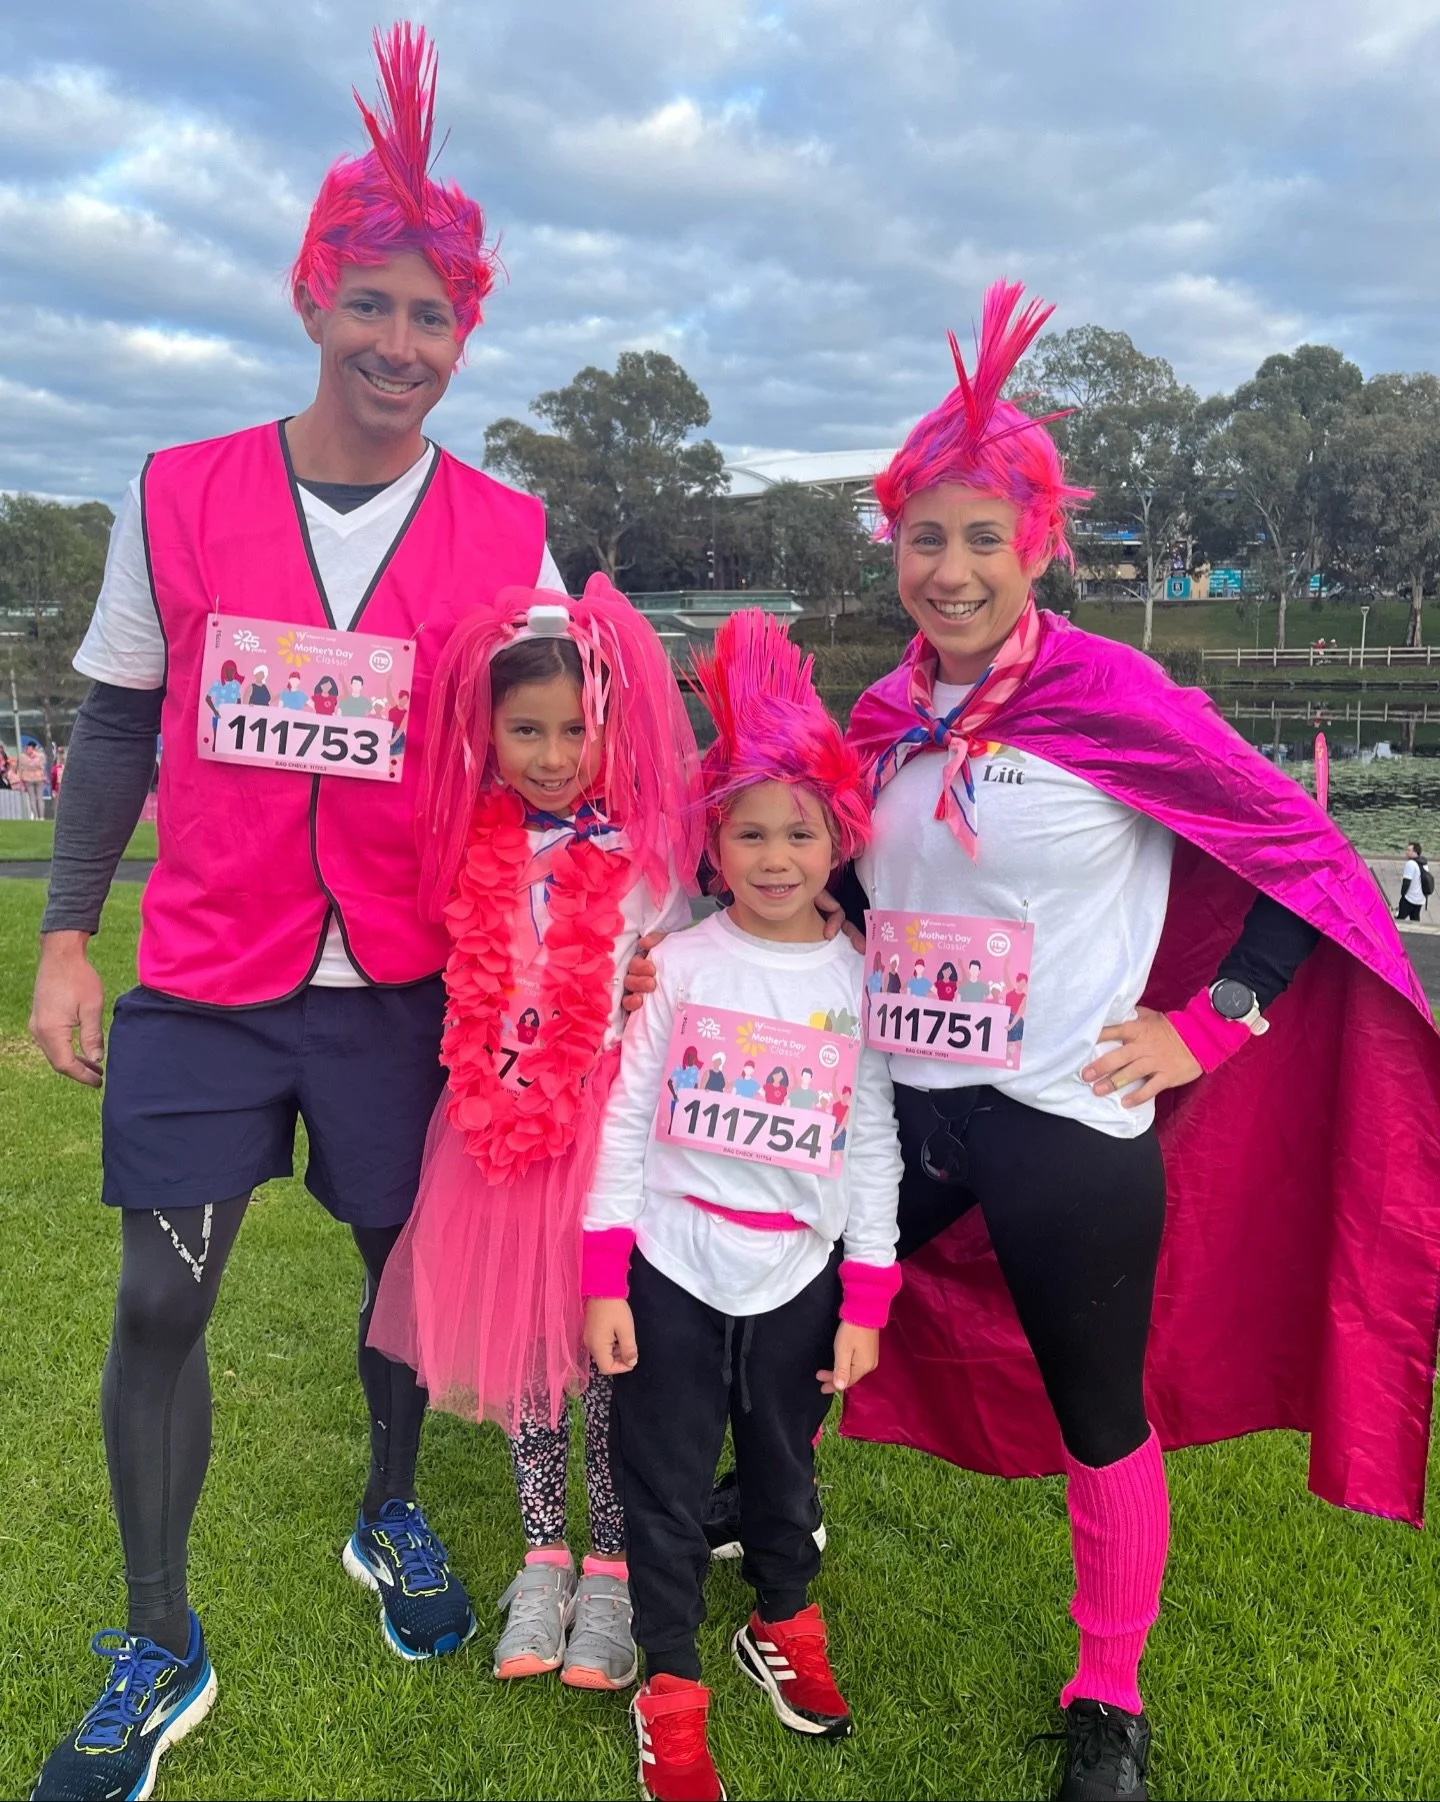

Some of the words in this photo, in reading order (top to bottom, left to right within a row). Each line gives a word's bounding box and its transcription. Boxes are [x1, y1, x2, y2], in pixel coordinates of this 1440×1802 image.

[294, 643, 334, 656] Mother's
[336, 649, 354, 660] Day
[315, 655, 348, 666] Classic
[228, 715, 379, 765] 111753
[919, 931, 953, 941] Mother's
[955, 933, 972, 944] Day
[937, 941, 966, 952] Classic
[877, 1004, 992, 1052] 111751
[751, 1033, 788, 1047] Mother's
[789, 1040, 807, 1052] Day
[770, 1045, 801, 1058] Classic
[684, 1100, 822, 1159] 111754
